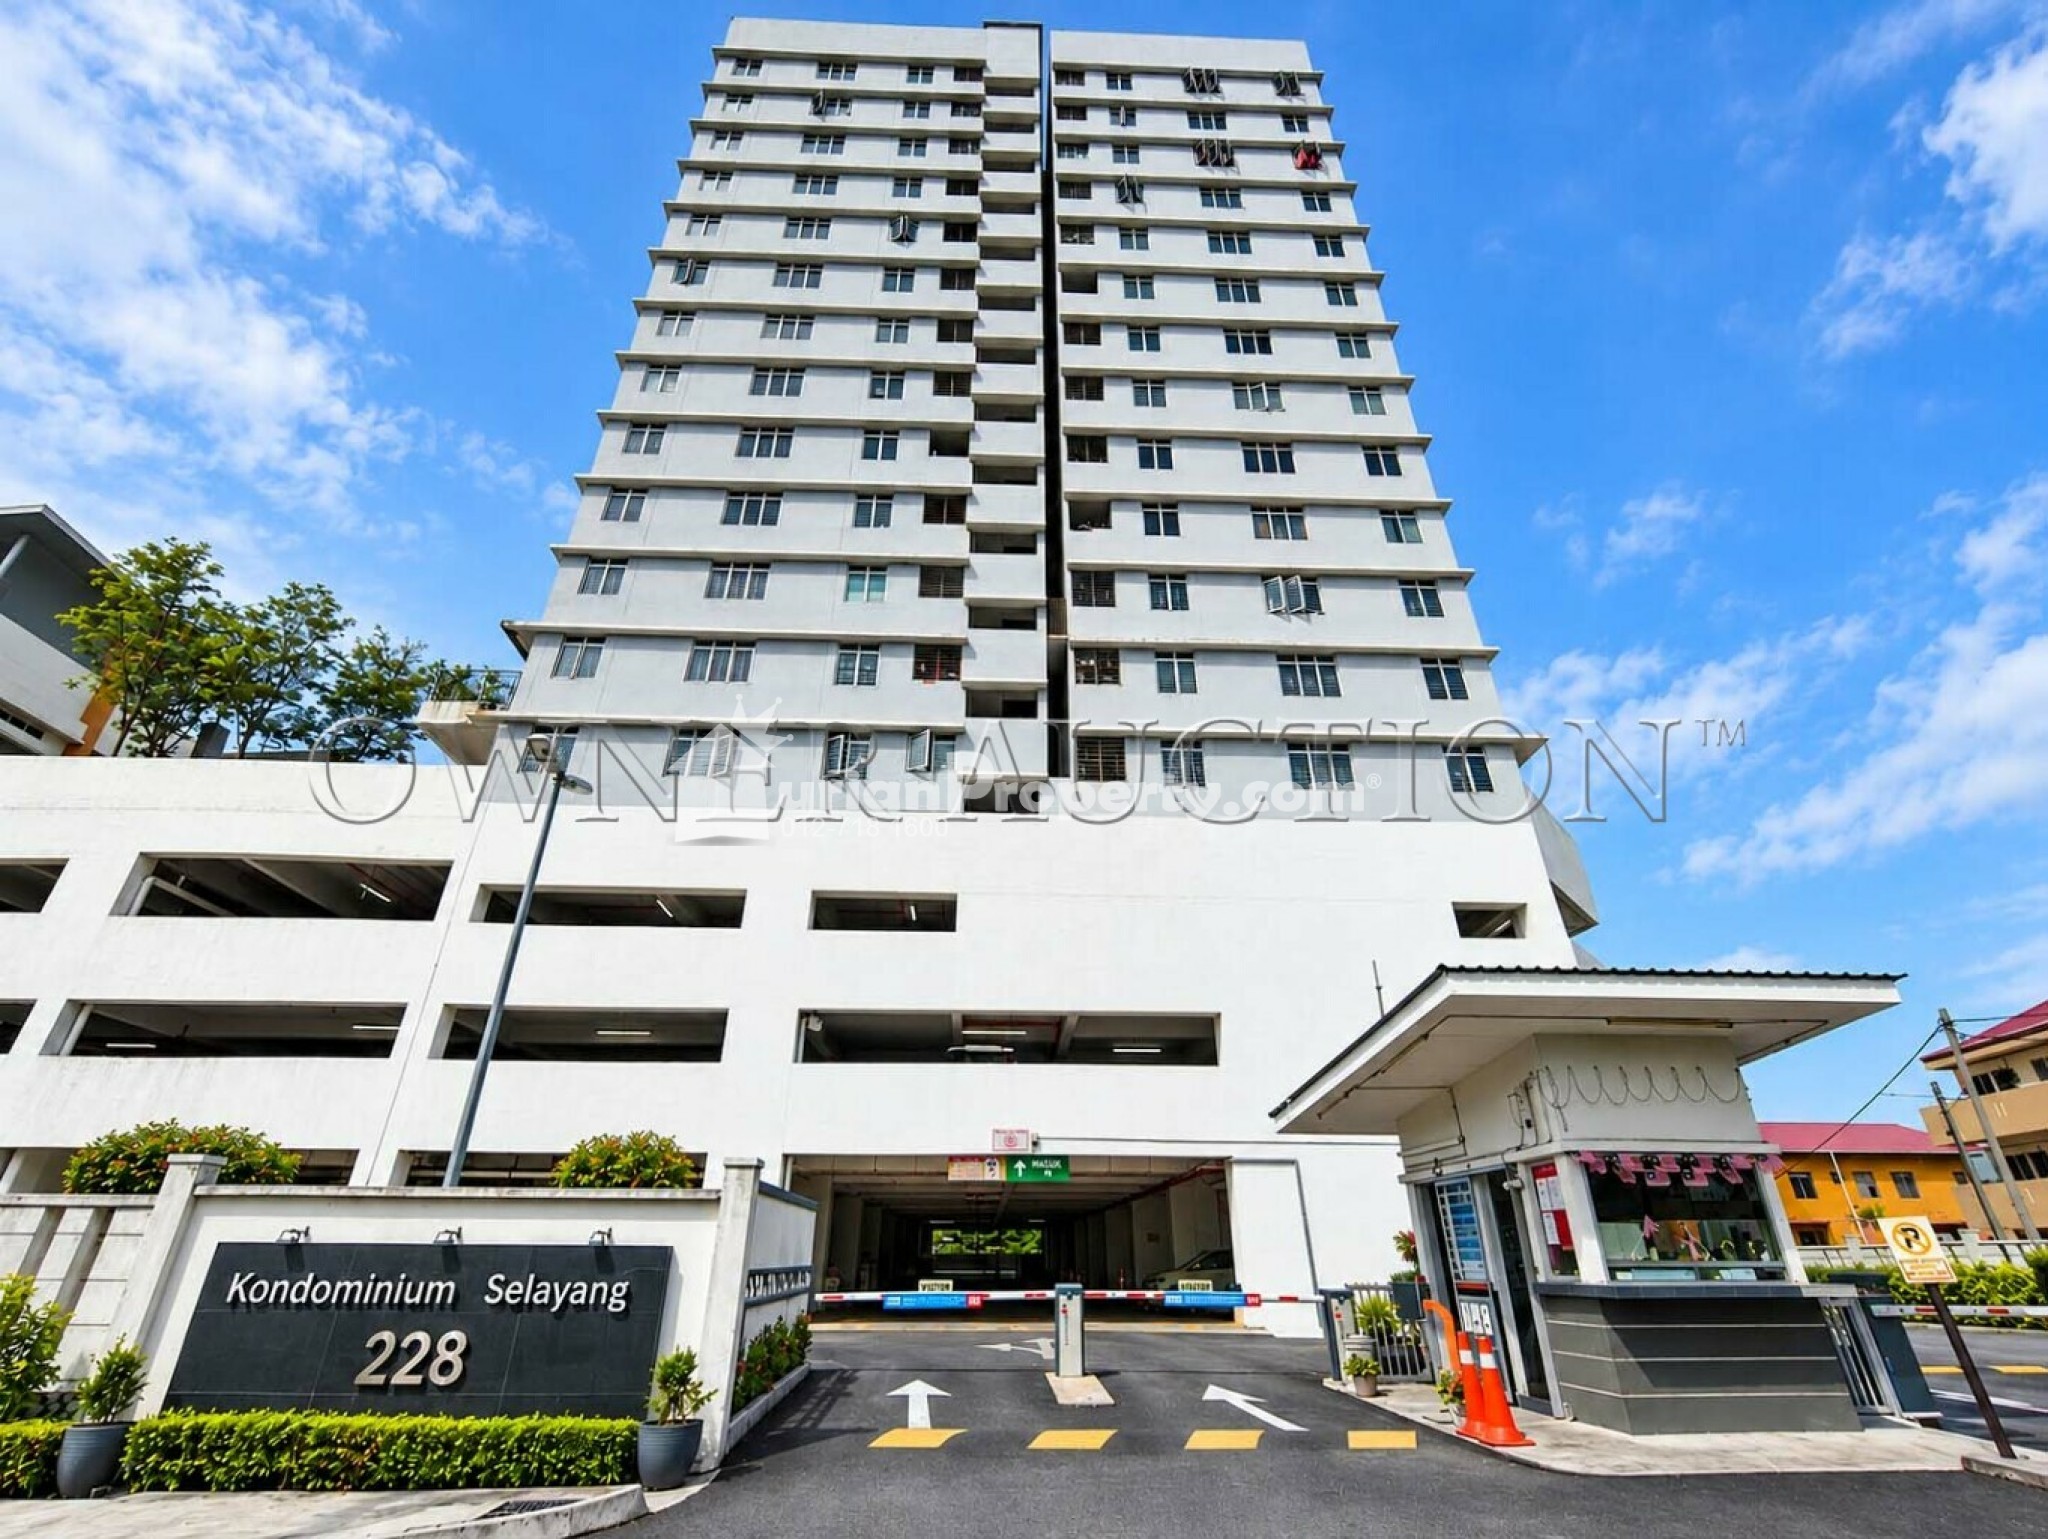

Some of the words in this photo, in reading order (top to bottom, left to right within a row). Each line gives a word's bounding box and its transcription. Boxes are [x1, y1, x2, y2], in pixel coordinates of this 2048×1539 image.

[227, 1272, 456, 1305] Kondominium
[484, 1272, 630, 1312] Selayang
[354, 1330, 468, 1387] 228
